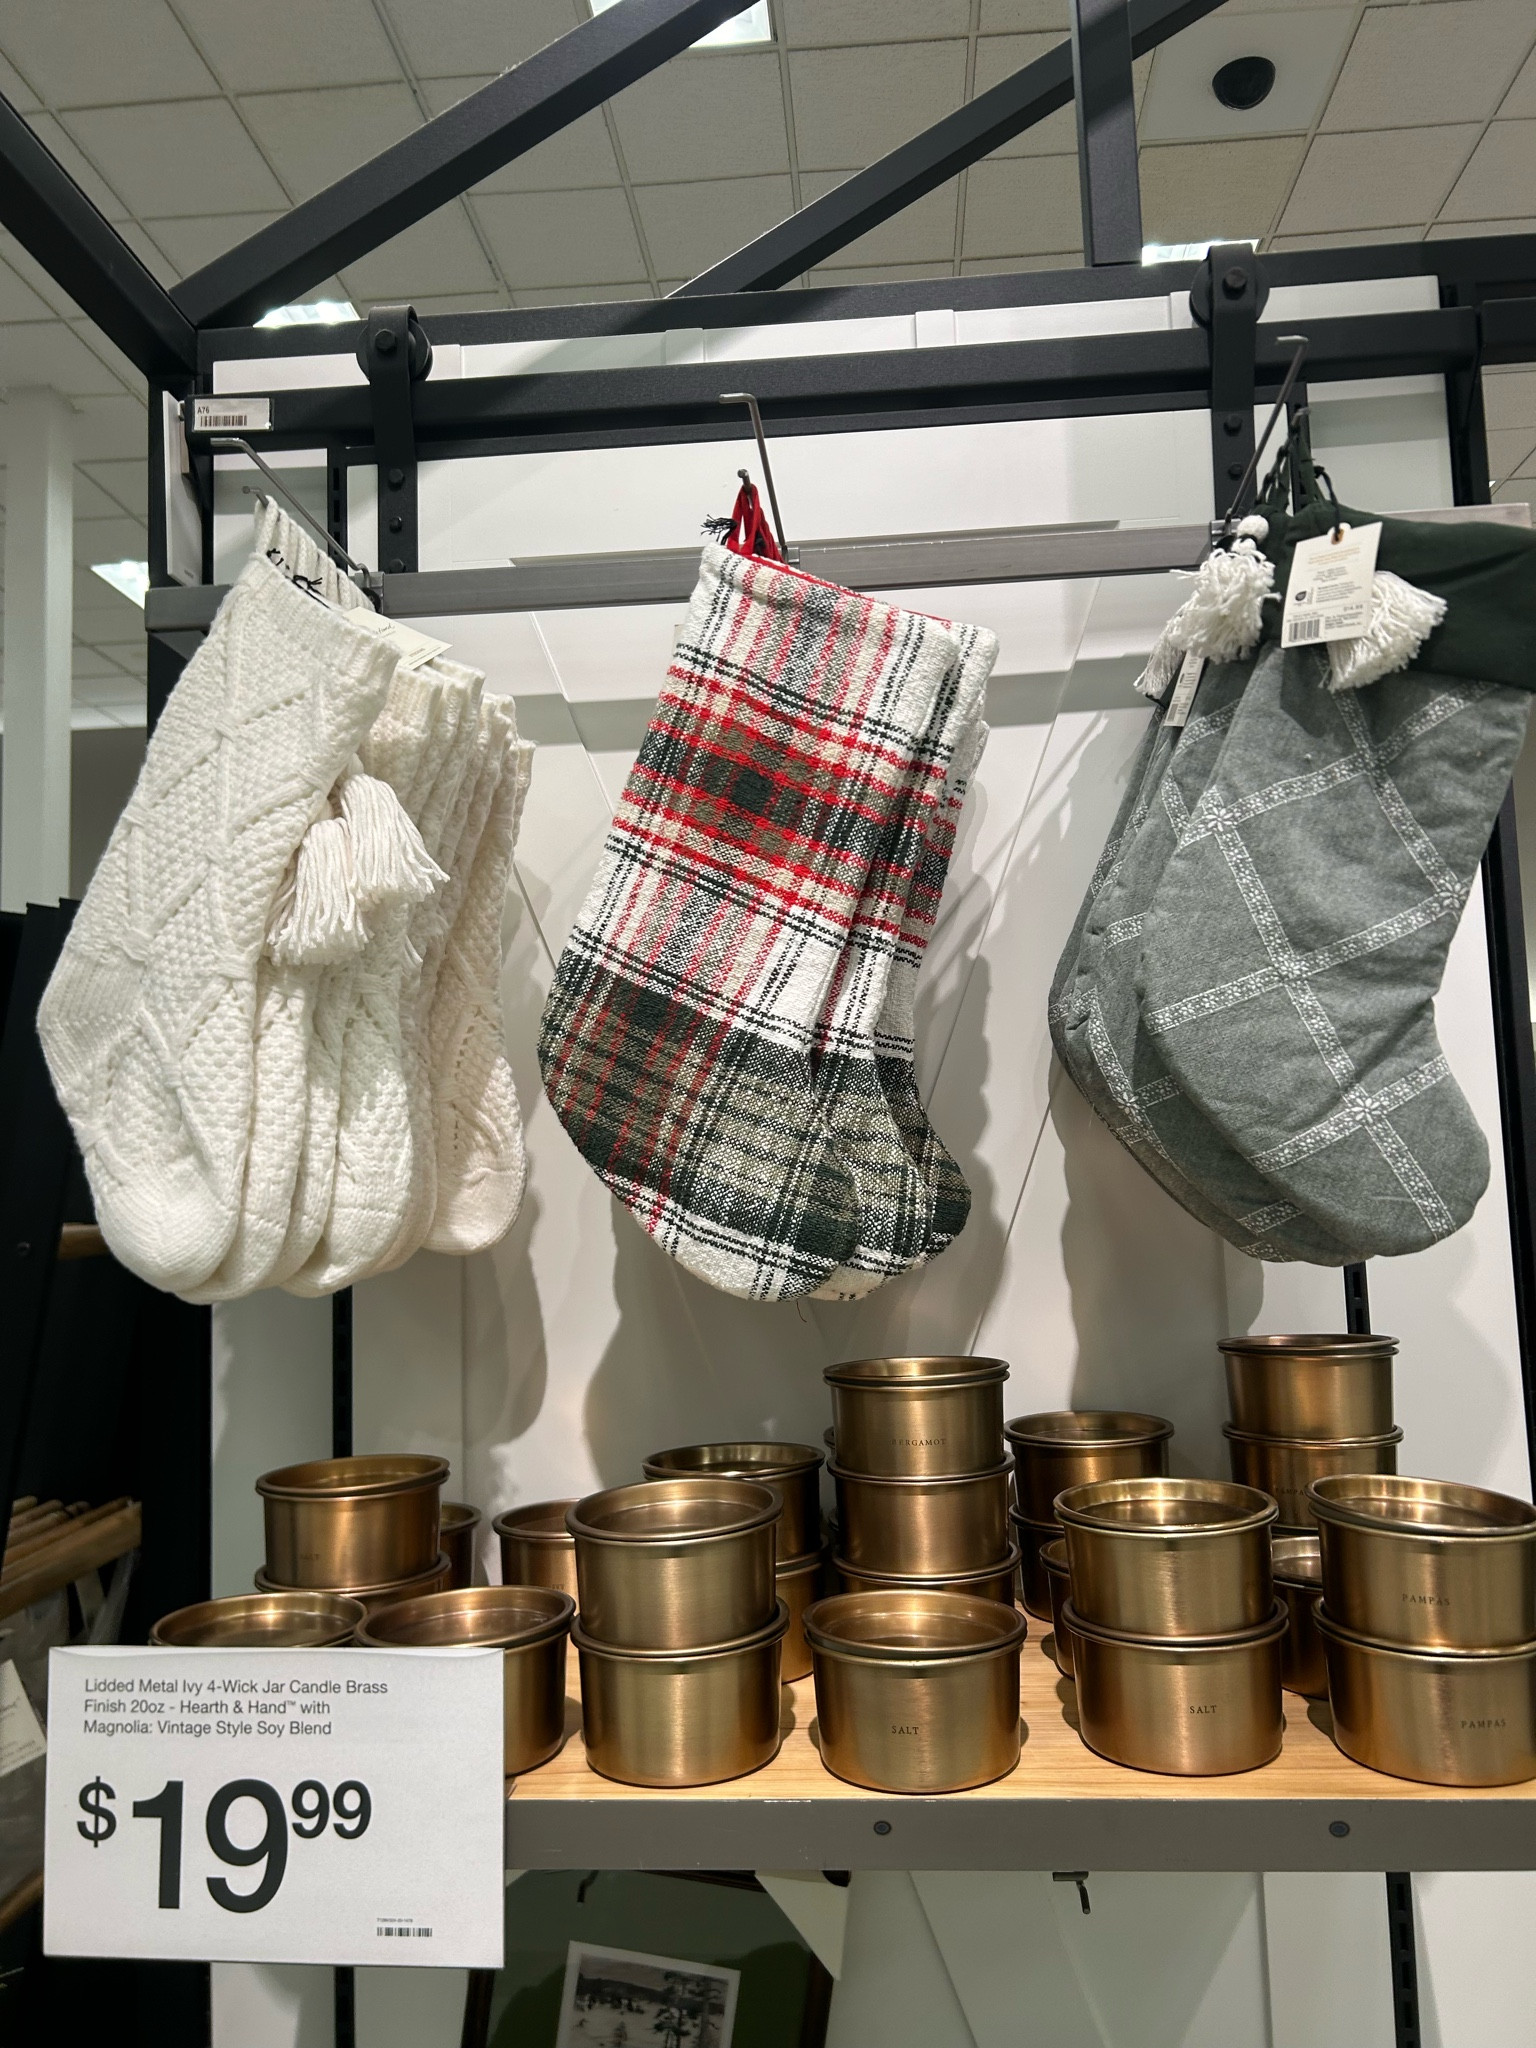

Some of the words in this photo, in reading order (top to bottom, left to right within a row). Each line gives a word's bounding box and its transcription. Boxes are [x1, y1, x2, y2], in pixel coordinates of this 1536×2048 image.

[197, 406, 210, 414] A76
[1402, 1593, 1450, 1606] PAMPAS
[84, 1678, 135, 1693] Lidded
[139, 1679, 178, 1693] Metal
[183, 1679, 203, 1697] Ivy
[207, 1679, 258, 1694] 4-Wick
[262, 1680, 285, 1694] Jar
[289, 1680, 341, 1694] Candle
[346, 1680, 388, 1694] Brass
[84, 1699, 126, 1713] Finish
[130, 1699, 165, 1713] 20oz
[180, 1700, 228, 1714] Hearth
[233, 1700, 243, 1714] &
[300, 1701, 330, 1714] with
[1189, 1705, 1217, 1714] SALT
[83, 1720, 153, 1736] Magnolia:
[157, 1720, 211, 1737] Vintage
[216, 1720, 252, 1738] Style
[257, 1721, 285, 1738] Soy
[290, 1721, 332, 1735] Blend
[1461, 1719, 1506, 1729] PAMPAS
[891, 1726, 919, 1735] SALT
